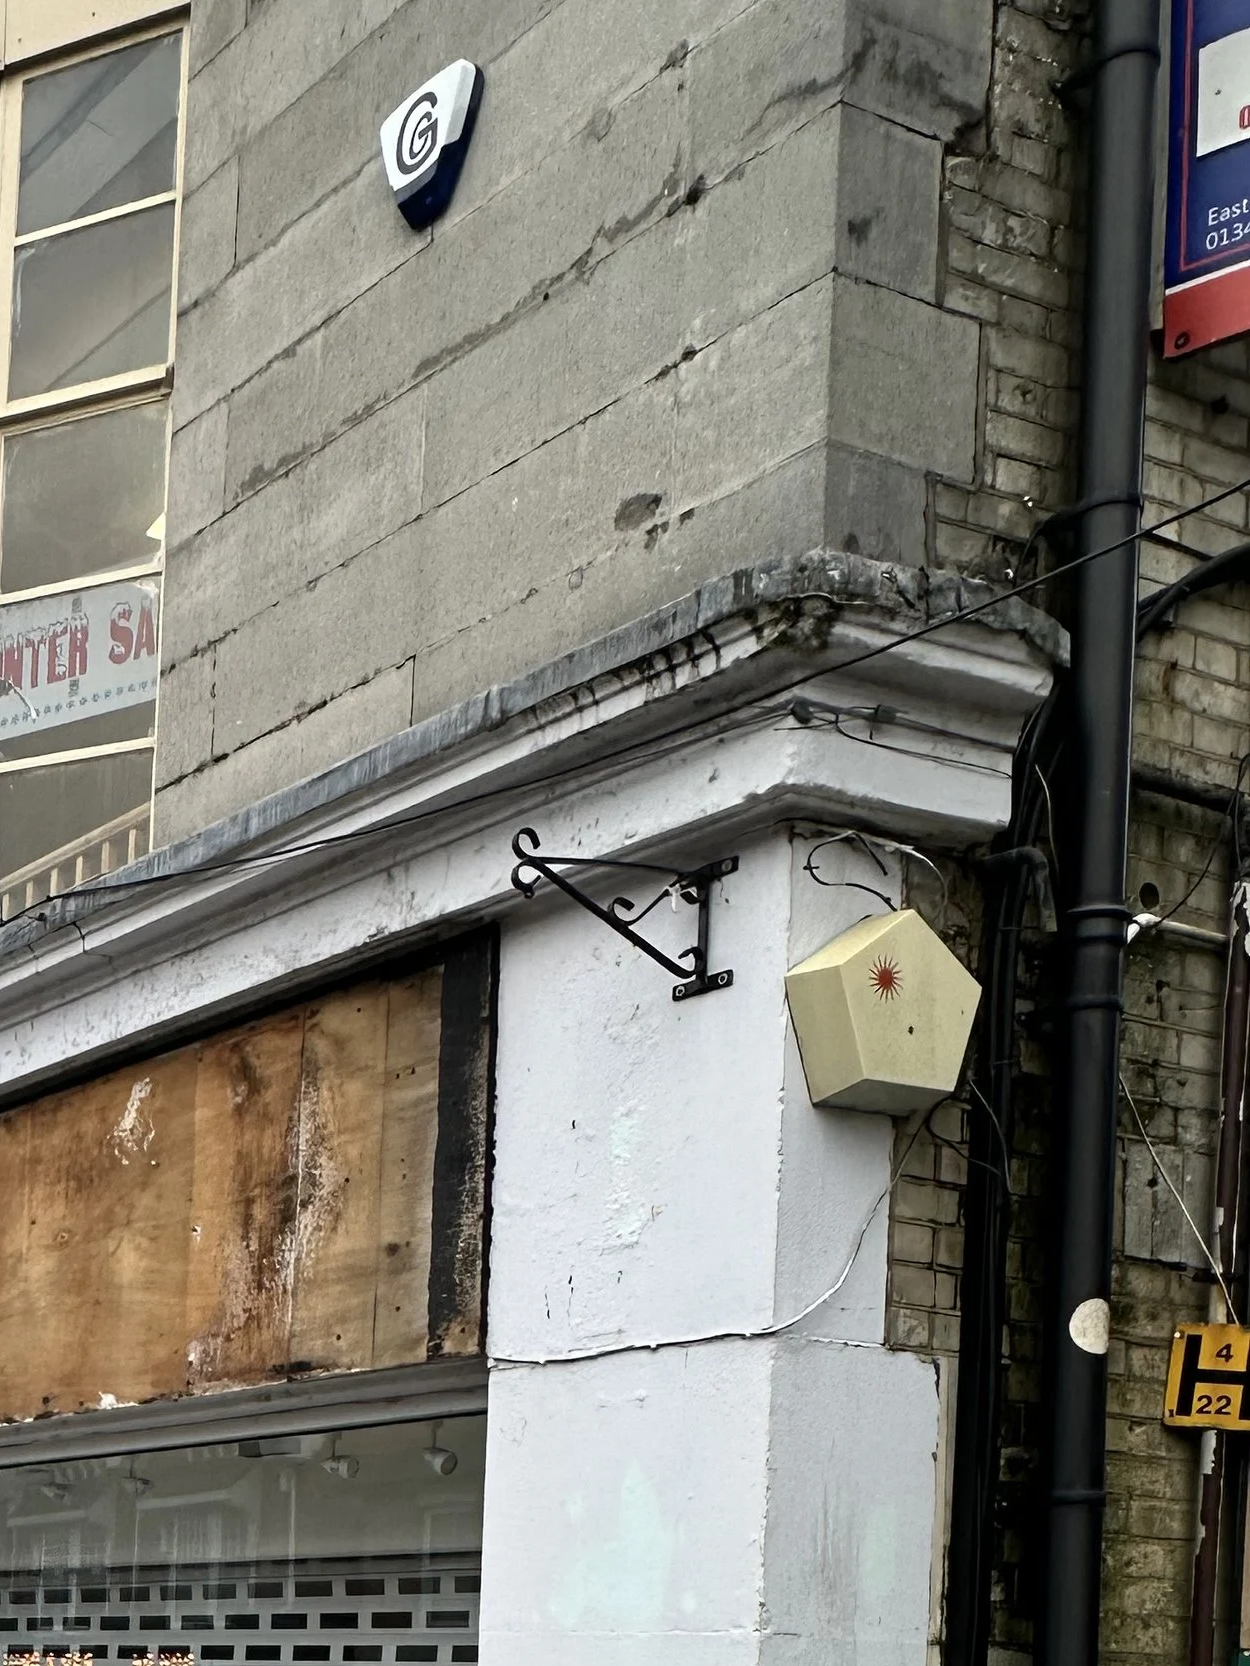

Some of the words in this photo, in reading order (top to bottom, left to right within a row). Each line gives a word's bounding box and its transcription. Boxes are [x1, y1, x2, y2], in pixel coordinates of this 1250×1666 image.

[108, 594, 159, 665] SA
[1215, 1343, 1234, 1363] 4
[1195, 1394, 1232, 1415] 22
